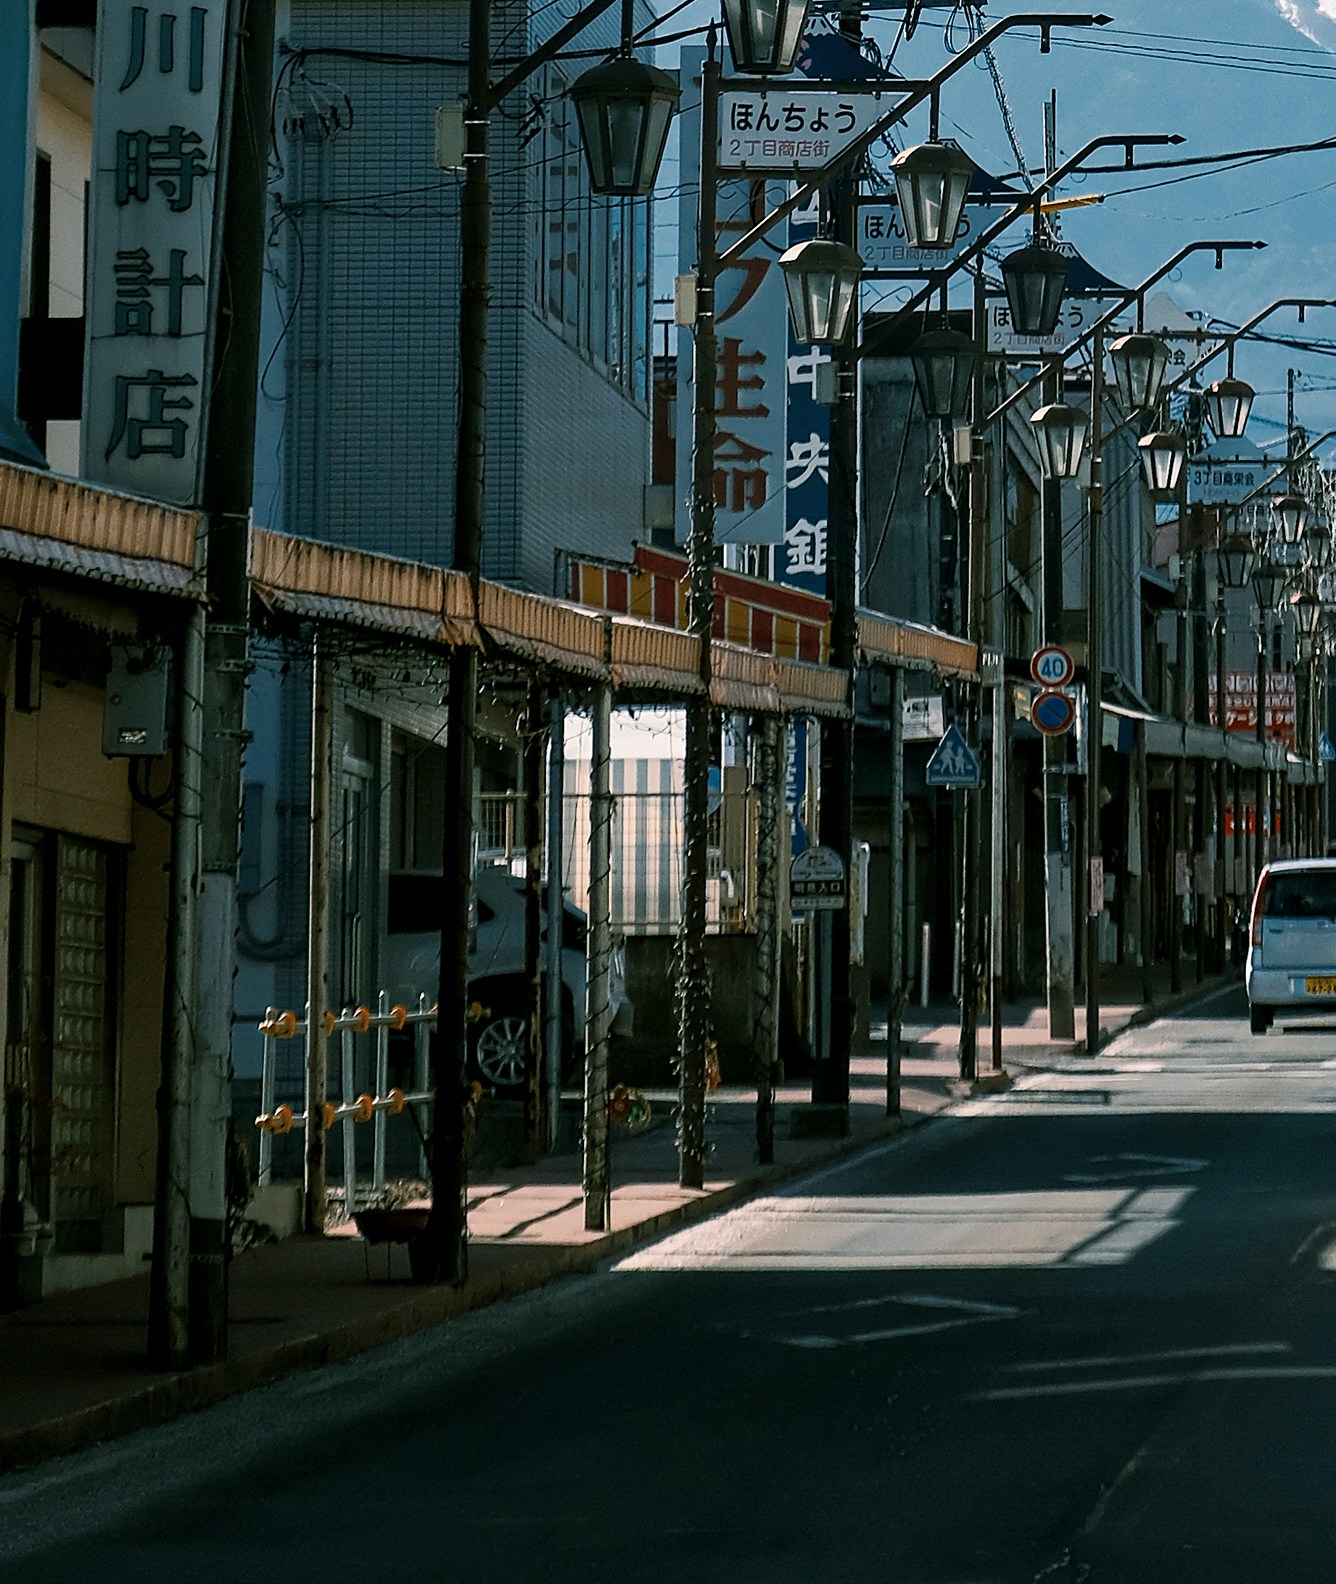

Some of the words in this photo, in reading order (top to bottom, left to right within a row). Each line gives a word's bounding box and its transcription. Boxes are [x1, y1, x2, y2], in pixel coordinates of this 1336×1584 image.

[730, 102, 856, 134] ほんちょう
[729, 139, 830, 159] 2丁目商店街
[864, 213, 971, 240] ほんう
[1040, 657, 1064, 677] 40
